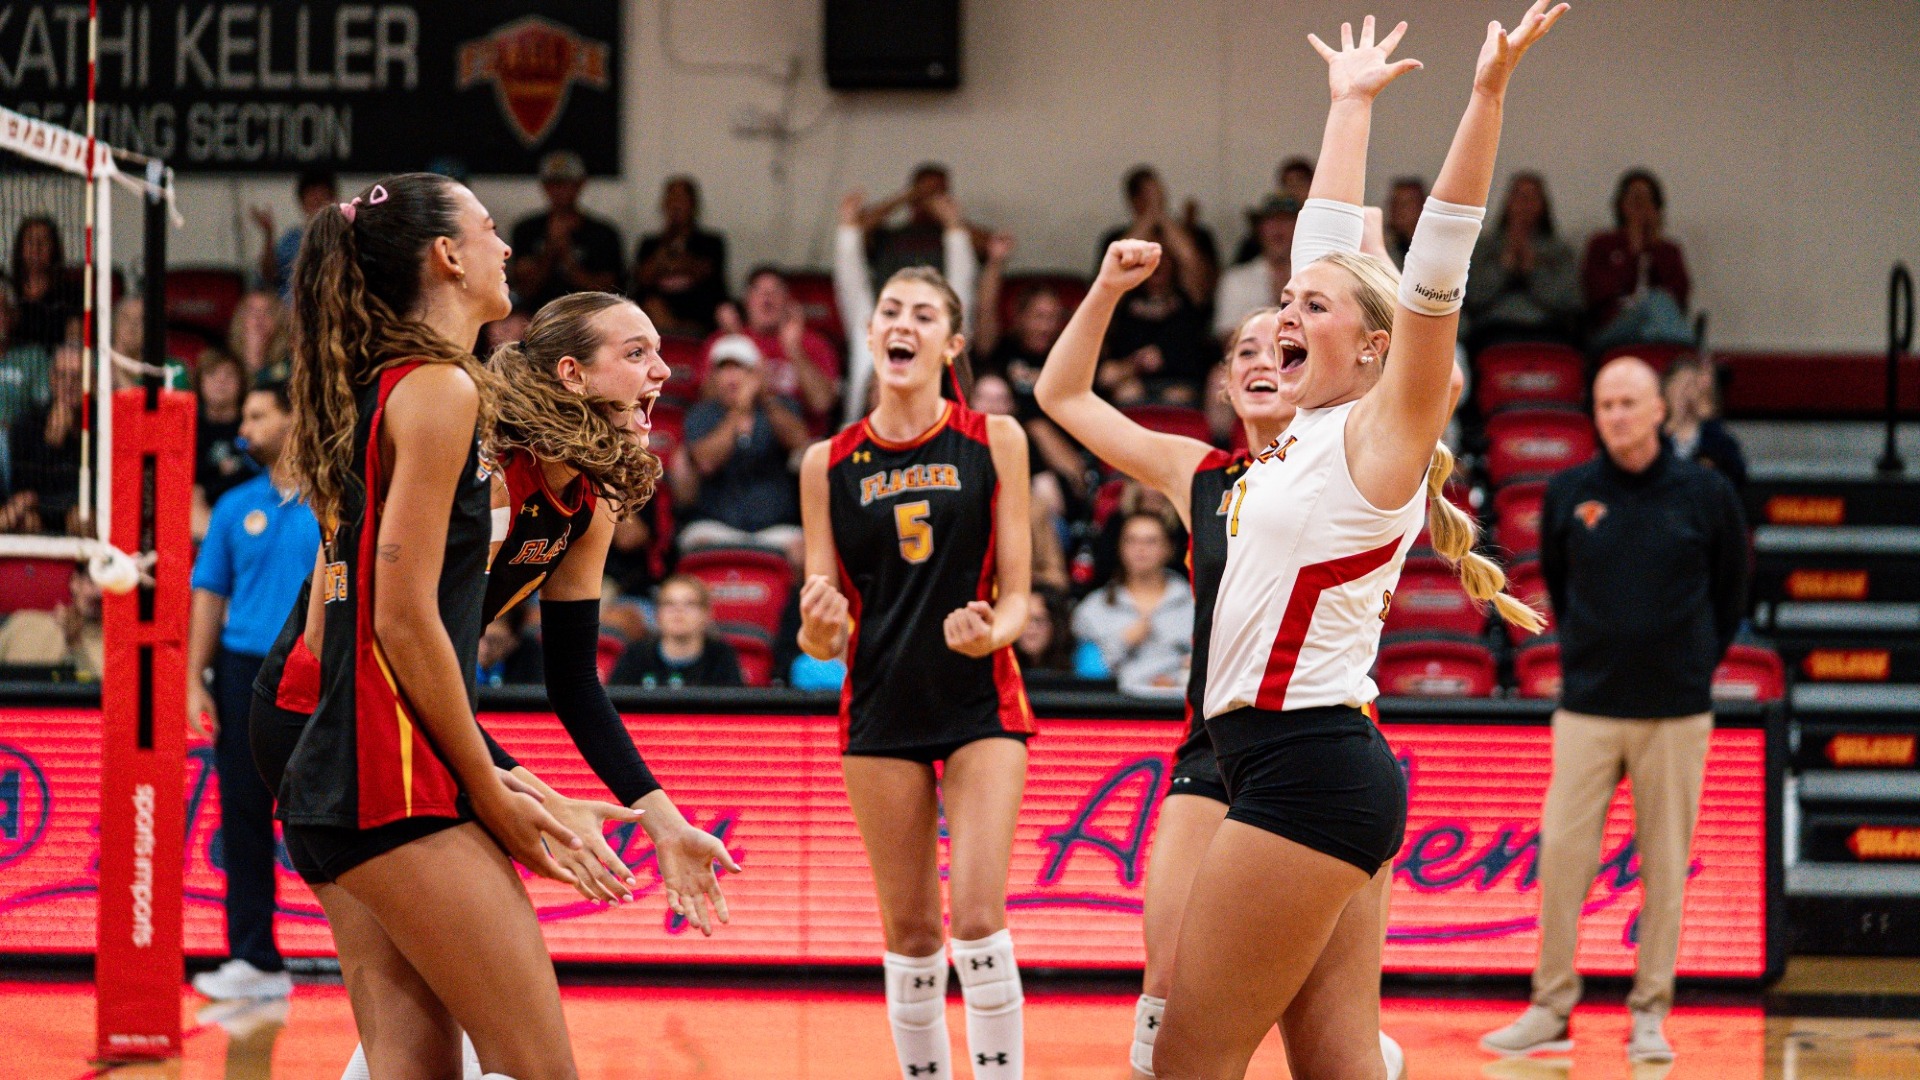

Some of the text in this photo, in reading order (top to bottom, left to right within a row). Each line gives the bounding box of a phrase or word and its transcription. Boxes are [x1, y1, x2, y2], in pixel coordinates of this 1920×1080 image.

[175, 3, 419, 90] KELLER
[187, 102, 353, 161] SECTION
[860, 463, 961, 506] FLAGLER
[893, 499, 934, 565] 5
[131, 783, 156, 856] sports
